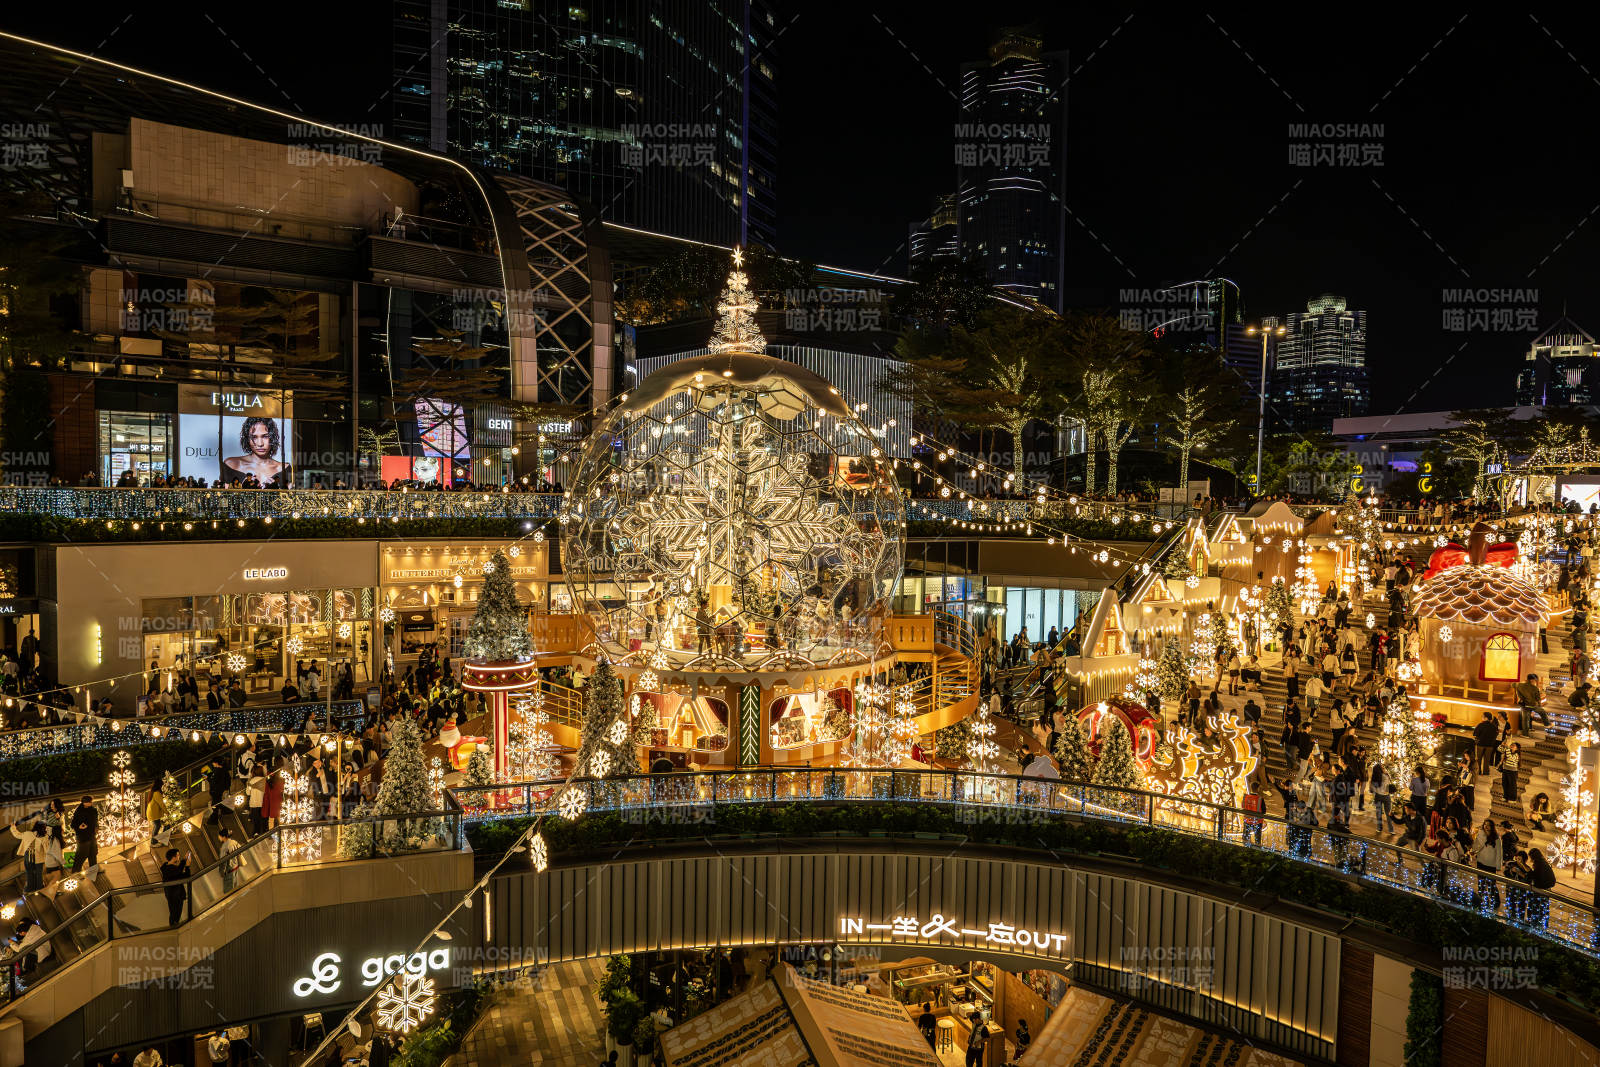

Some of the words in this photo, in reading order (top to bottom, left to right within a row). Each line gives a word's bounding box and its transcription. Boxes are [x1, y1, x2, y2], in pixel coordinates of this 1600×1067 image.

[212, 392, 262, 408] DJULA
[538, 422, 572, 433] NSTER
[245, 570, 258, 579] LE
[261, 569, 287, 578] LABO
[391, 569, 453, 579] BUTTERFUL
[361, 946, 450, 988] gaga
